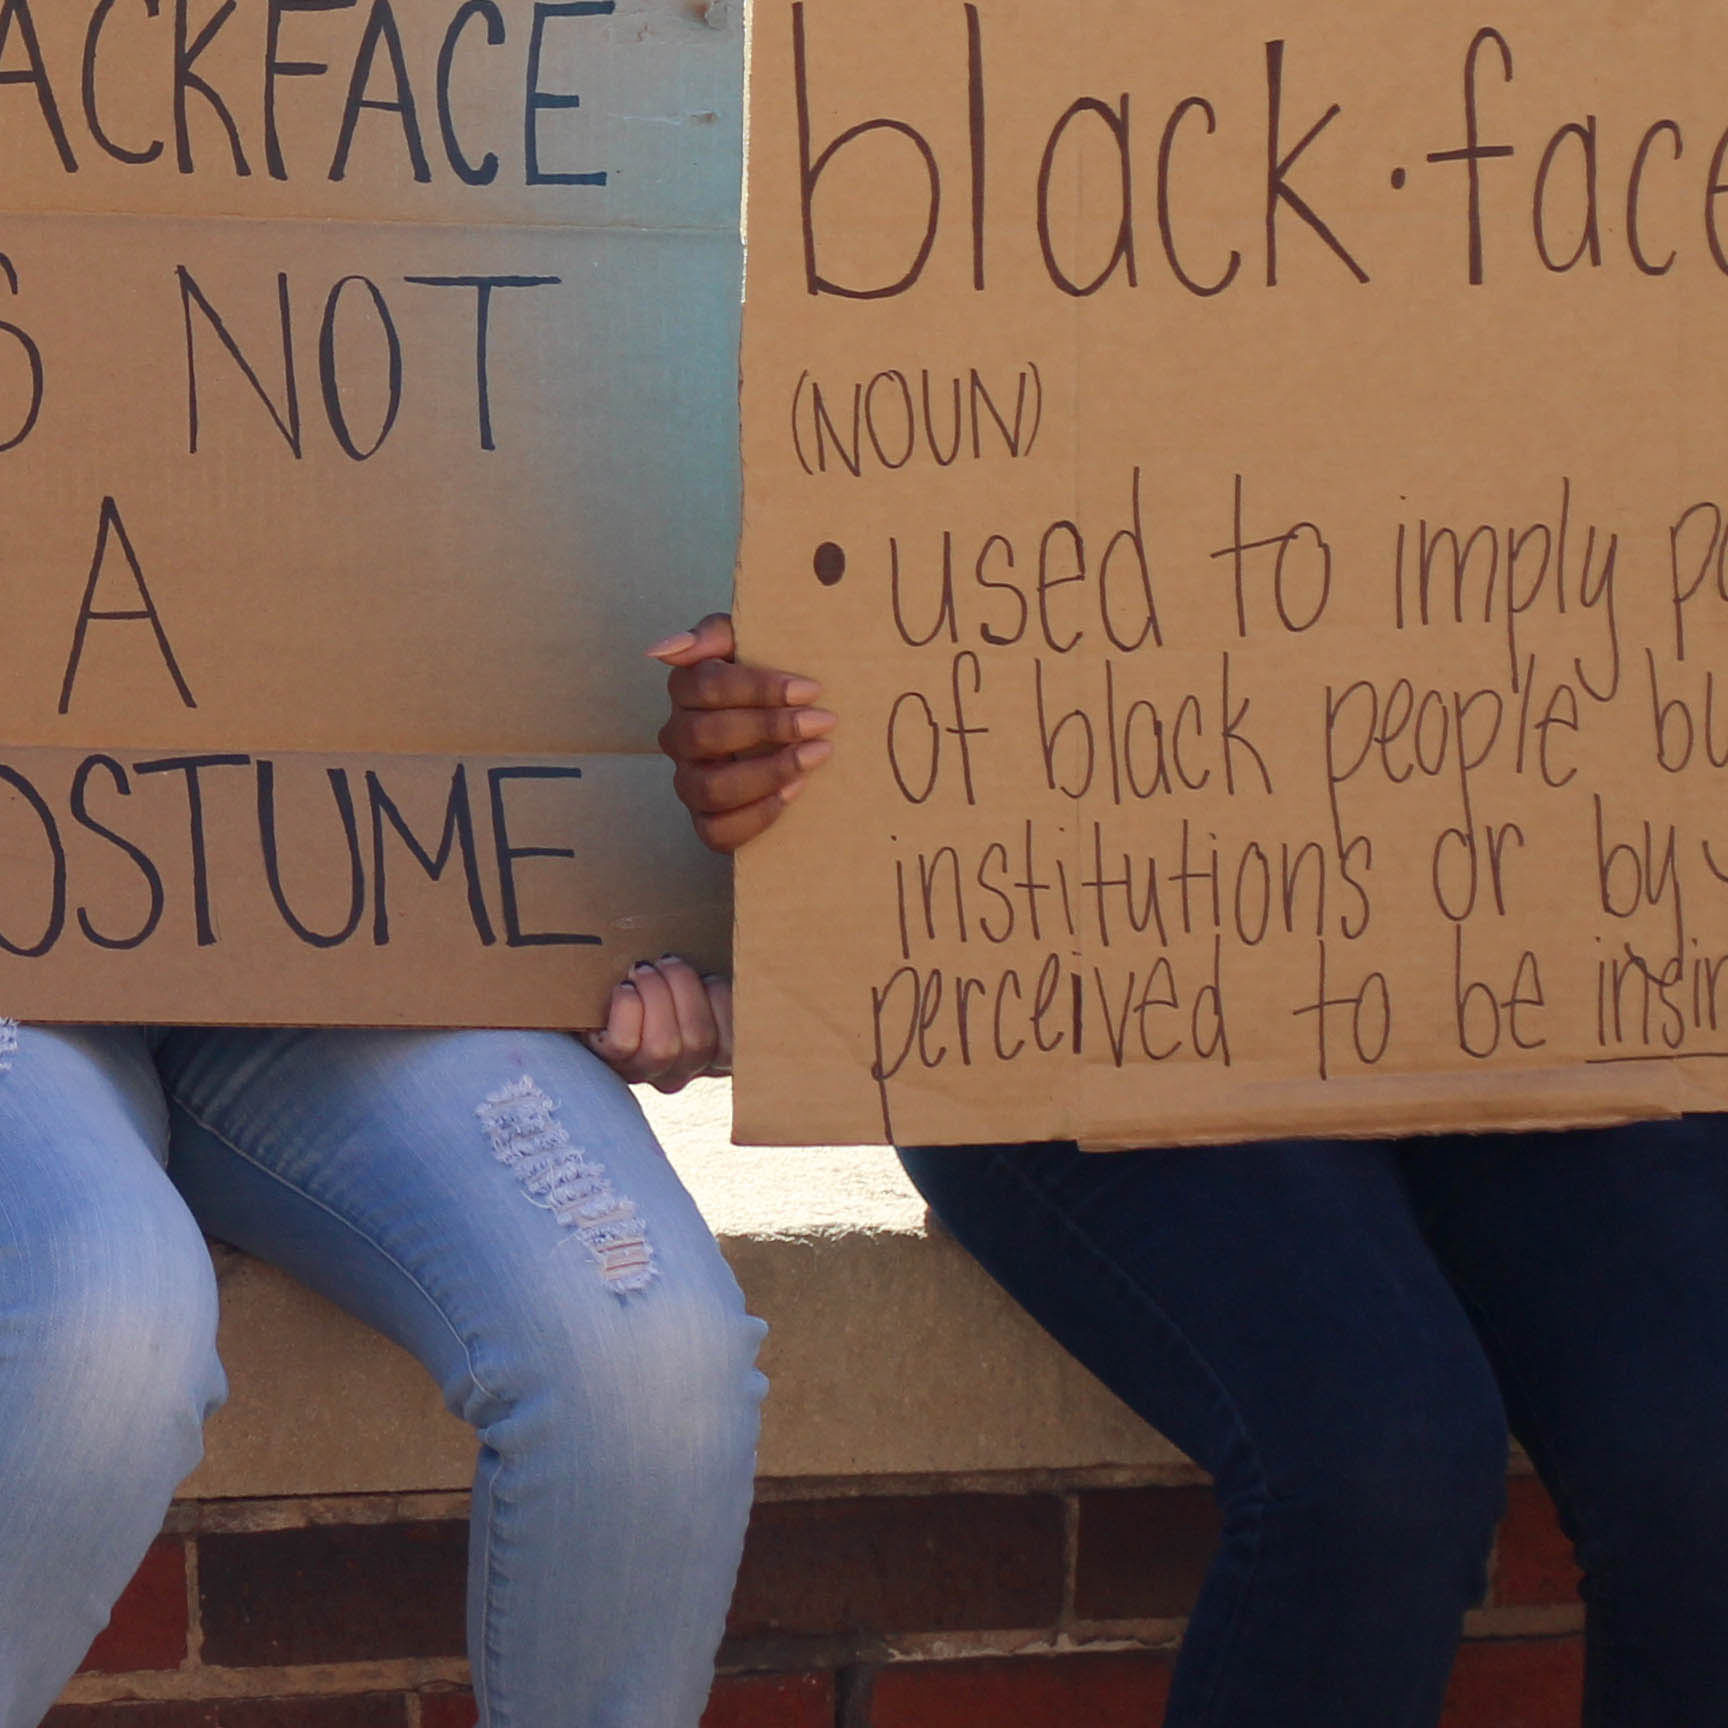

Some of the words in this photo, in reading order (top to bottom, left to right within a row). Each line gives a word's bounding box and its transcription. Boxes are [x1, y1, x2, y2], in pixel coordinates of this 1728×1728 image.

[177, 265, 562, 461] NOT
[792, 361, 1042, 476] (NOUN)
[59, 496, 196, 714] A
[890, 466, 1162, 653] used
[1210, 474, 1331, 637] to
[1394, 476, 1620, 702] imply
[887, 651, 990, 805] of
[1036, 651, 1272, 805] black
[1326, 652, 1581, 858] people
[891, 818, 1371, 958] institutions
[1434, 823, 1524, 921] or
[1594, 793, 1684, 984] by
[872, 933, 1230, 1143] perceived
[1292, 939, 1390, 1079] to
[1457, 924, 1546, 1058] be
